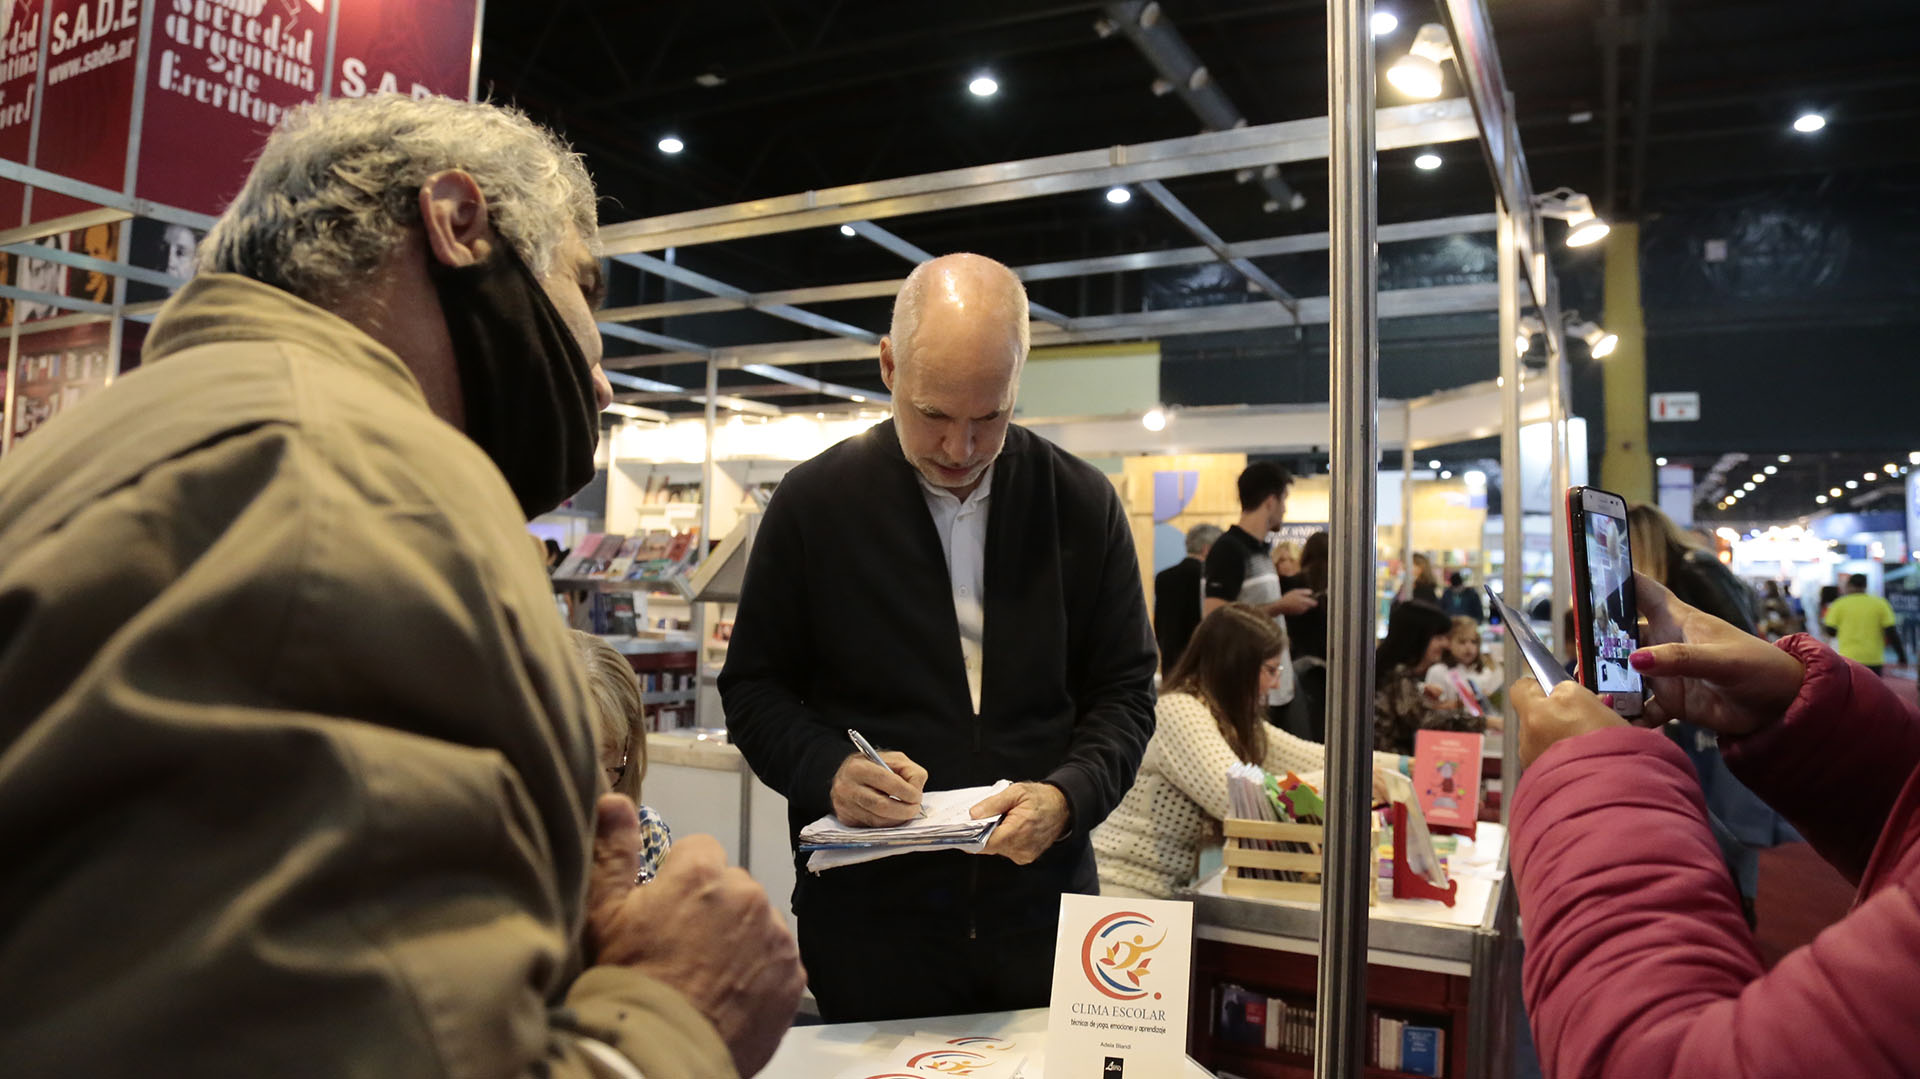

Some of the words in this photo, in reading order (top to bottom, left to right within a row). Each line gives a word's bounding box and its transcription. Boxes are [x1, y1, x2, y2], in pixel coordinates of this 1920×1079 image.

[1072, 1002, 1109, 1017] CLIMA
[1112, 1005, 1166, 1022] ESCOLAR
[1089, 1020, 1096, 1028] de
[1139, 1024, 1167, 1035] aprendizaje
